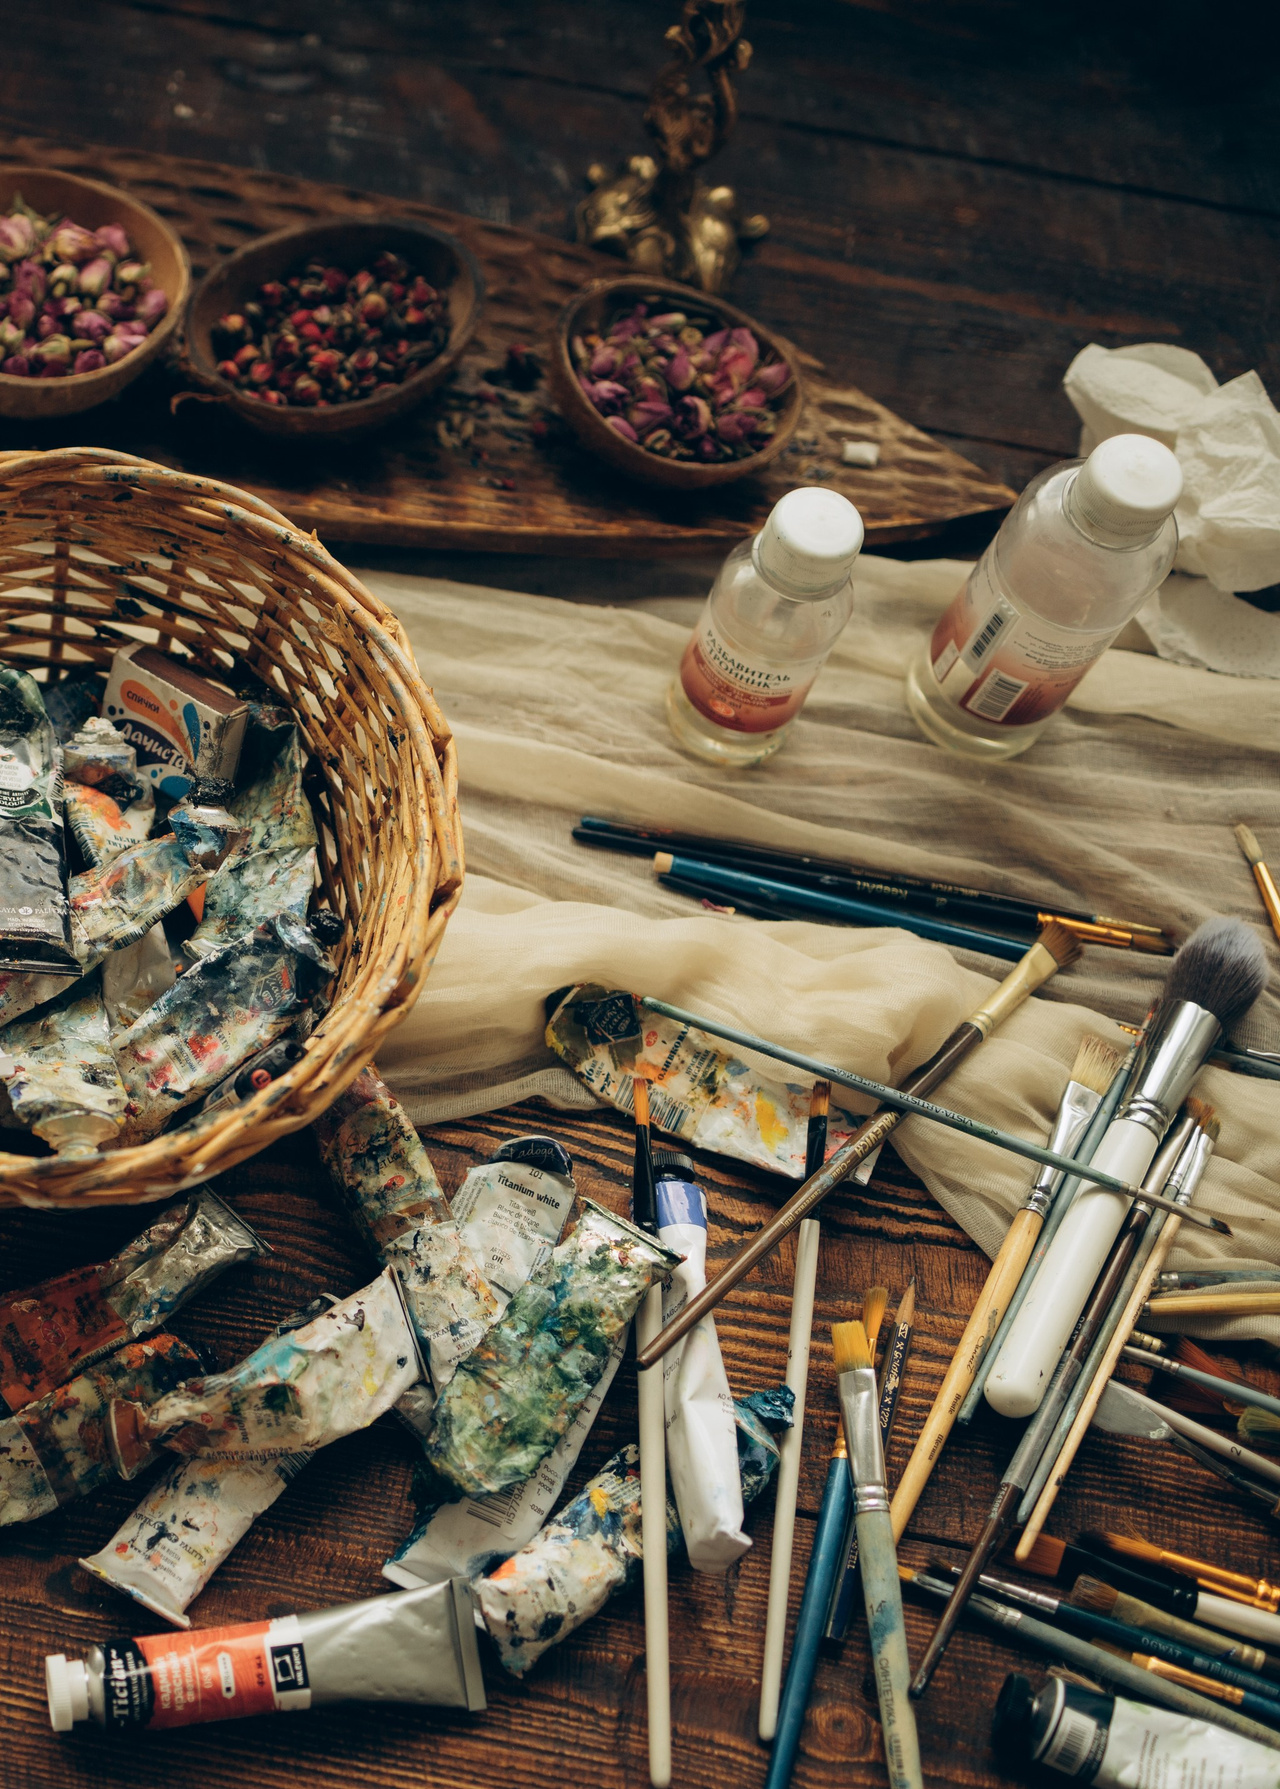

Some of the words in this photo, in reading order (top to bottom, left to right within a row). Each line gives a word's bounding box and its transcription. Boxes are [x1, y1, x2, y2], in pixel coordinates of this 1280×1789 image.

[836, 1068, 886, 1092] СИНТЕТИКА
[854, 1110, 901, 1158] MALEVICH
[528, 1168, 544, 1180] 101
[497, 1174, 535, 1198] Titanium
[536, 1192, 561, 1210] white
[496, 1204, 514, 1217] Blanc
[522, 1213, 540, 1229] titane
[492, 1254, 504, 1266] OIL
[948, 1392, 960, 1414] Bristle
[880, 1405, 892, 1428] 1222
[1230, 1446, 1242, 1457] 2
[878, 1657, 895, 1727] СИНТЕТИКА
